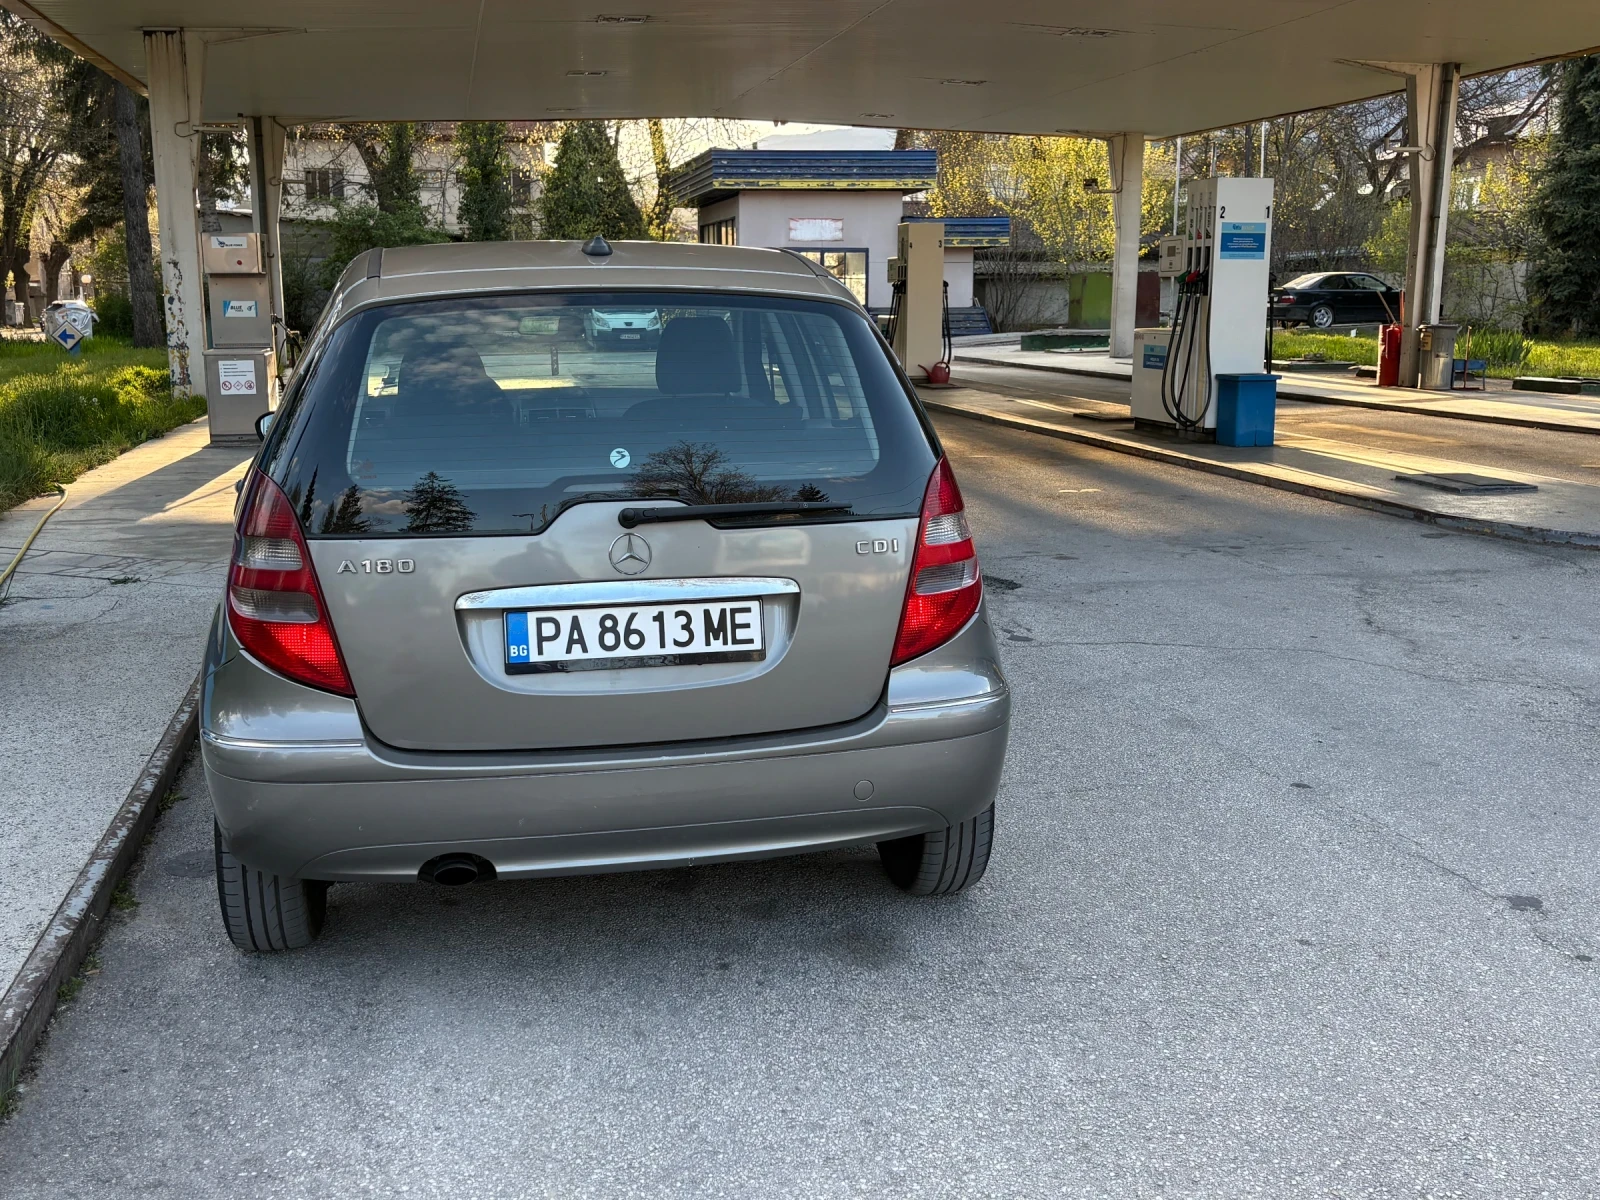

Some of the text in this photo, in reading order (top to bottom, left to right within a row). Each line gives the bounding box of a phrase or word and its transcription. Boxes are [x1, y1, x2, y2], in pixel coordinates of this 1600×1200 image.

[1219, 205, 1226, 219] 2
[1265, 205, 1271, 219] 1
[938, 239, 943, 249] 3
[855, 538, 899, 554] CDI
[509, 645, 528, 657] BG
